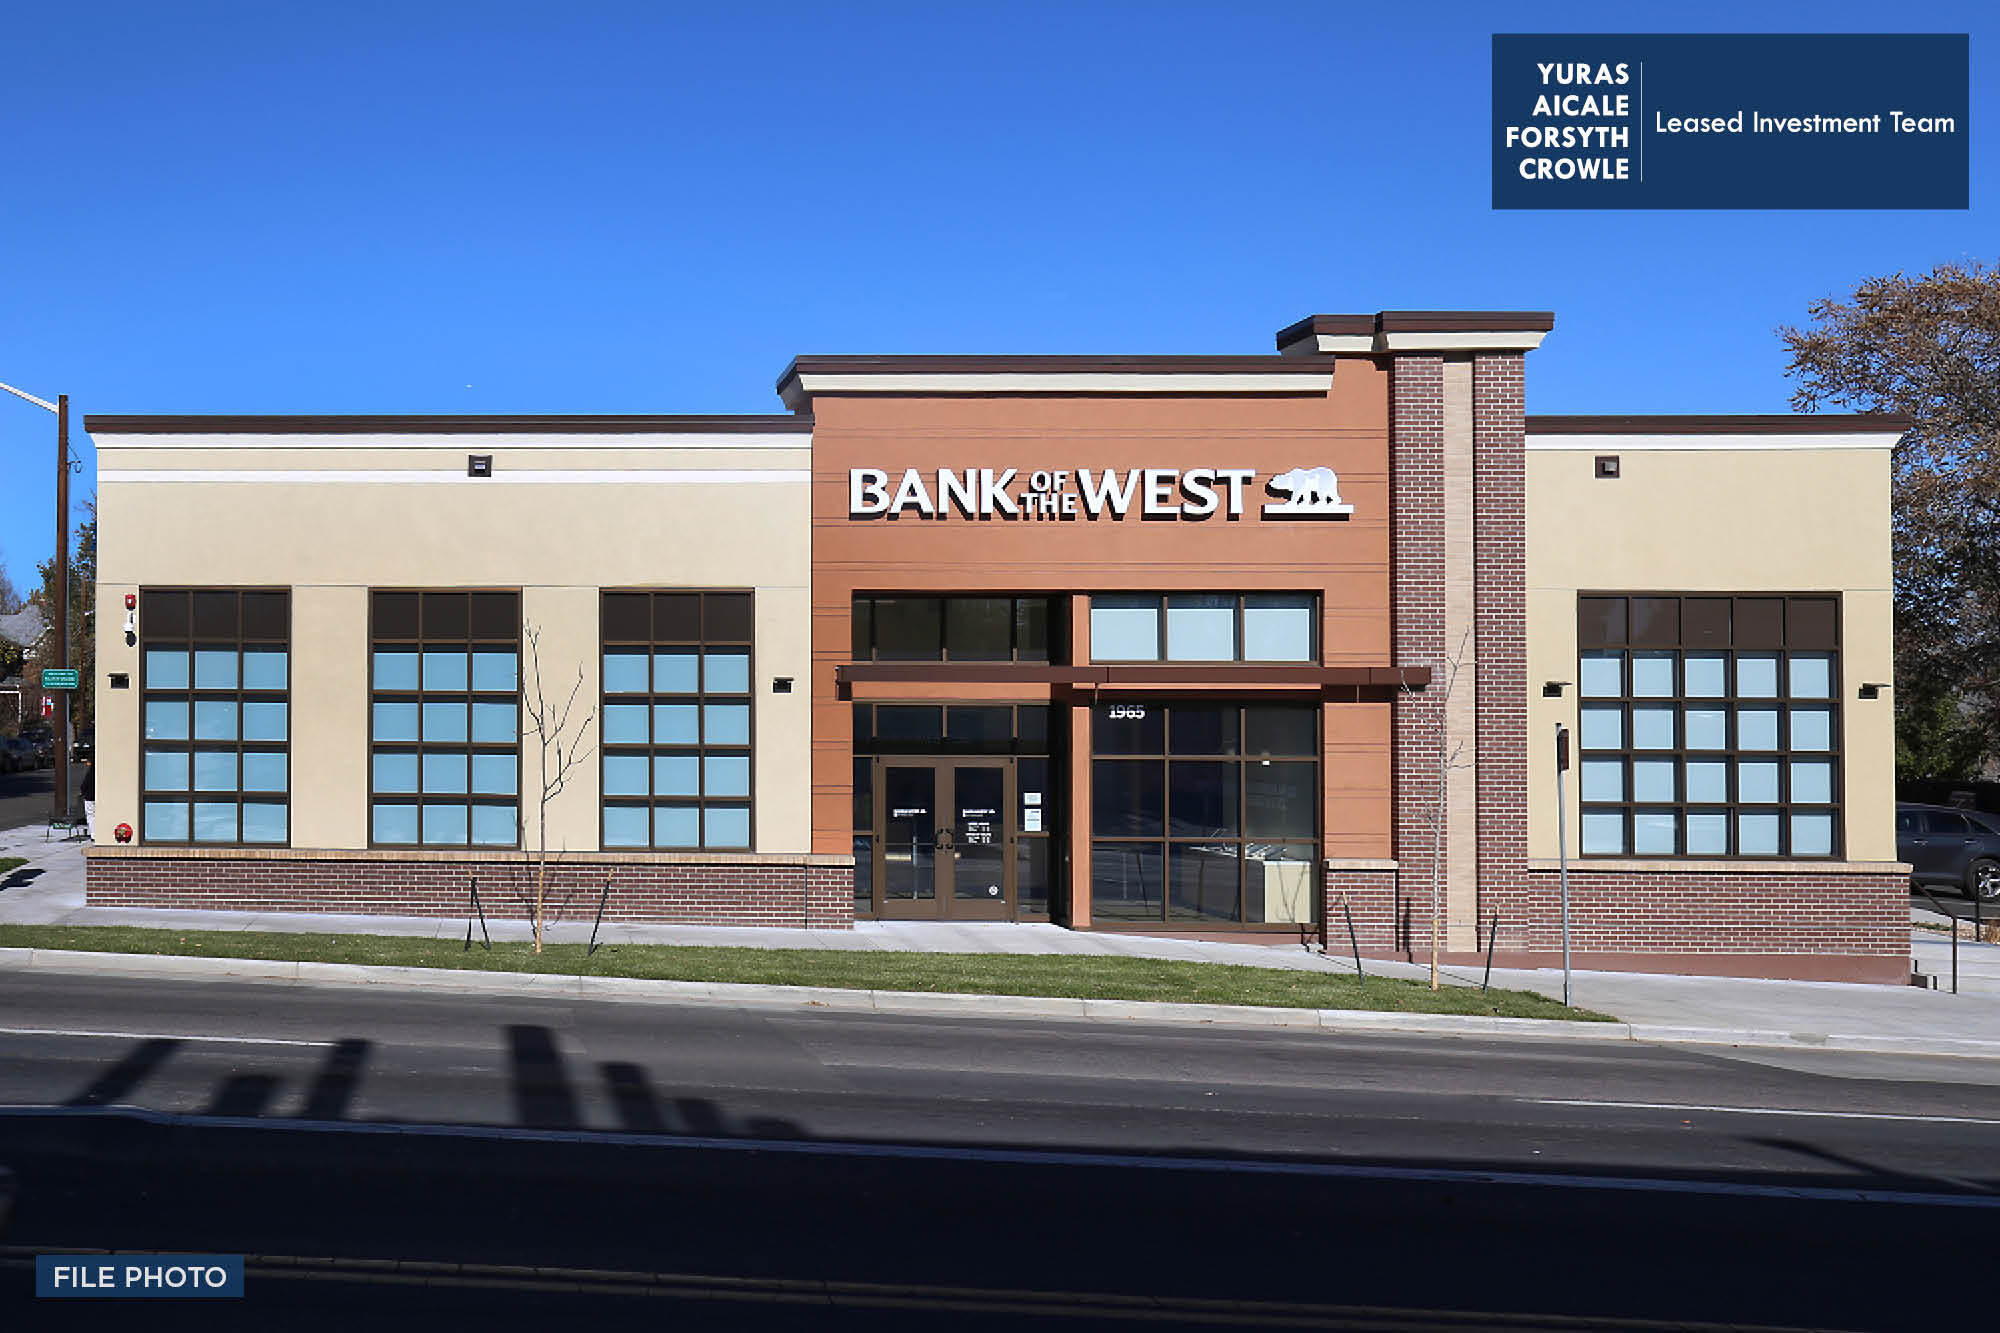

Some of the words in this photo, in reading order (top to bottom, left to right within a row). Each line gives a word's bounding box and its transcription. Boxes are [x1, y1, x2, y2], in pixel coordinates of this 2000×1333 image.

[849, 468, 1020, 517] BANK
[1030, 470, 1070, 492] OF
[1076, 468, 1256, 517] WEST
[1019, 492, 1079, 516] THE
[1108, 704, 1146, 720] 1965
